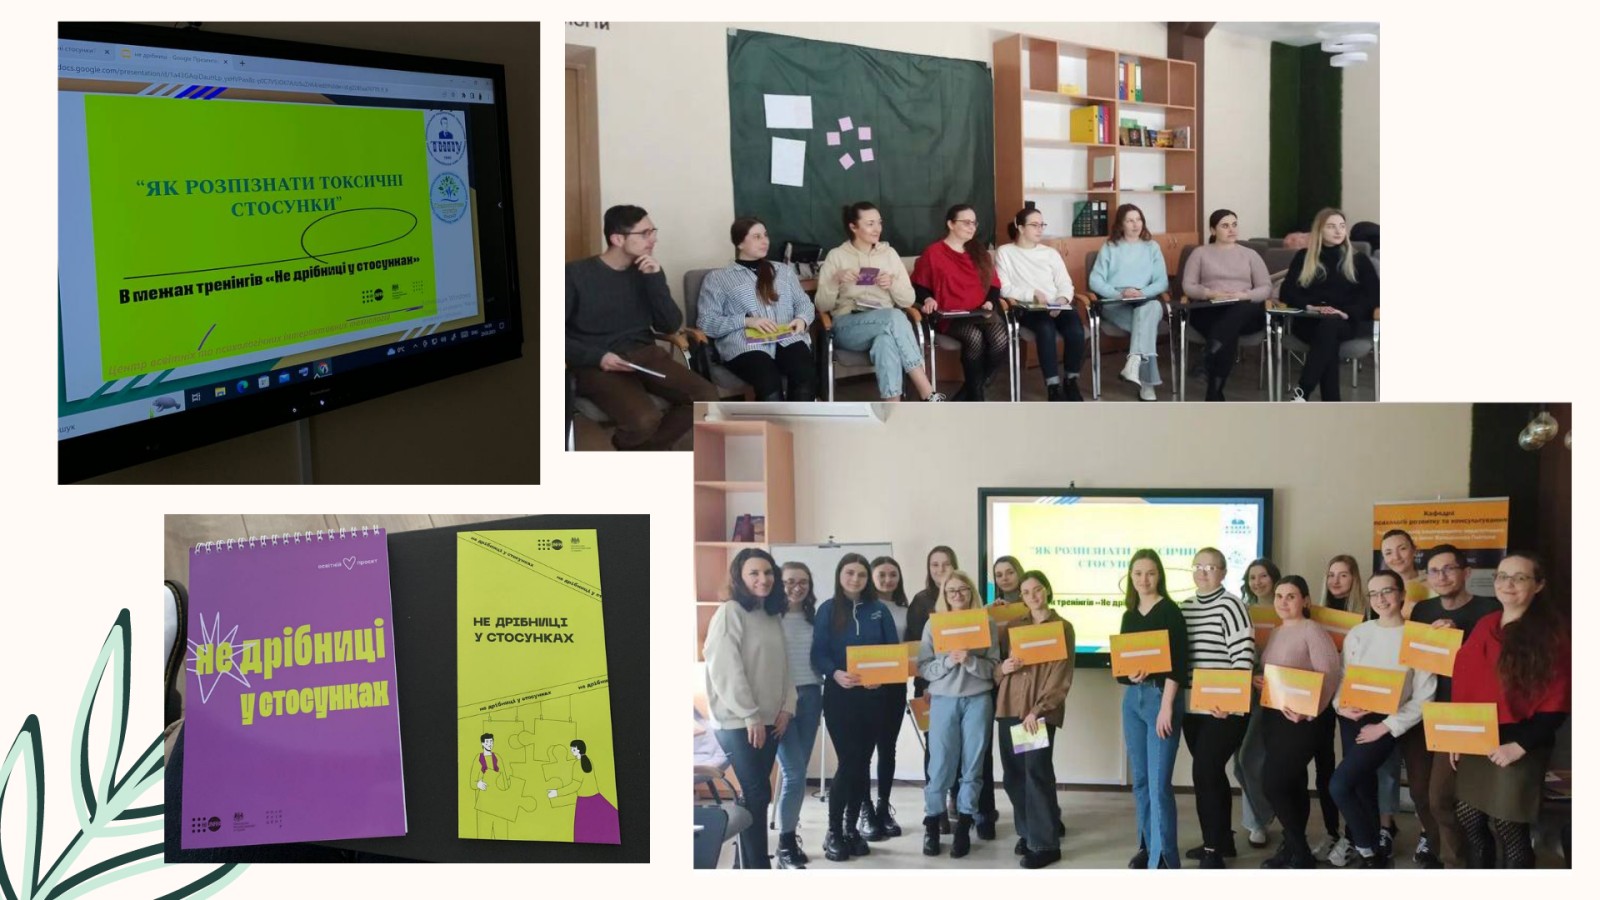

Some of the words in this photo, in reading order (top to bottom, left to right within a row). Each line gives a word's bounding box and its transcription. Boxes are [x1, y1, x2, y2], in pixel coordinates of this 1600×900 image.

[136, 179, 179, 197] “ЯК
[186, 176, 315, 195] РОЗПІЗНАТИ
[319, 174, 403, 190] ТОКСИЧНІ
[231, 196, 342, 217] СТОСУНКИ”
[119, 289, 130, 304] В
[133, 282, 193, 302] межах
[196, 273, 263, 295] тренінгів
[265, 268, 291, 284] «Не
[293, 261, 347, 282] дрібниці
[348, 262, 355, 275] у
[356, 255, 421, 273] стосунках»
[109, 360, 147, 376] Центр
[150, 351, 197, 368] освітніх
[198, 348, 214, 357] та
[215, 335, 282, 355] психологічних
[284, 322, 348, 340] інтерактивних
[477, 539, 502, 553] дрібниці
[563, 578, 591, 594] дрібниці
[1057, 598, 1094, 608] тренінгів
[473, 617, 491, 627] НЕ
[495, 617, 568, 628] ДРІБНИЦІ
[474, 632, 483, 643] У
[486, 632, 574, 643] СТОСУНКАХ
[195, 641, 233, 675] не
[239, 617, 386, 680] дрібниці
[240, 693, 256, 726] у
[258, 680, 390, 720] стосунках
[488, 699, 516, 711] дрібниці
